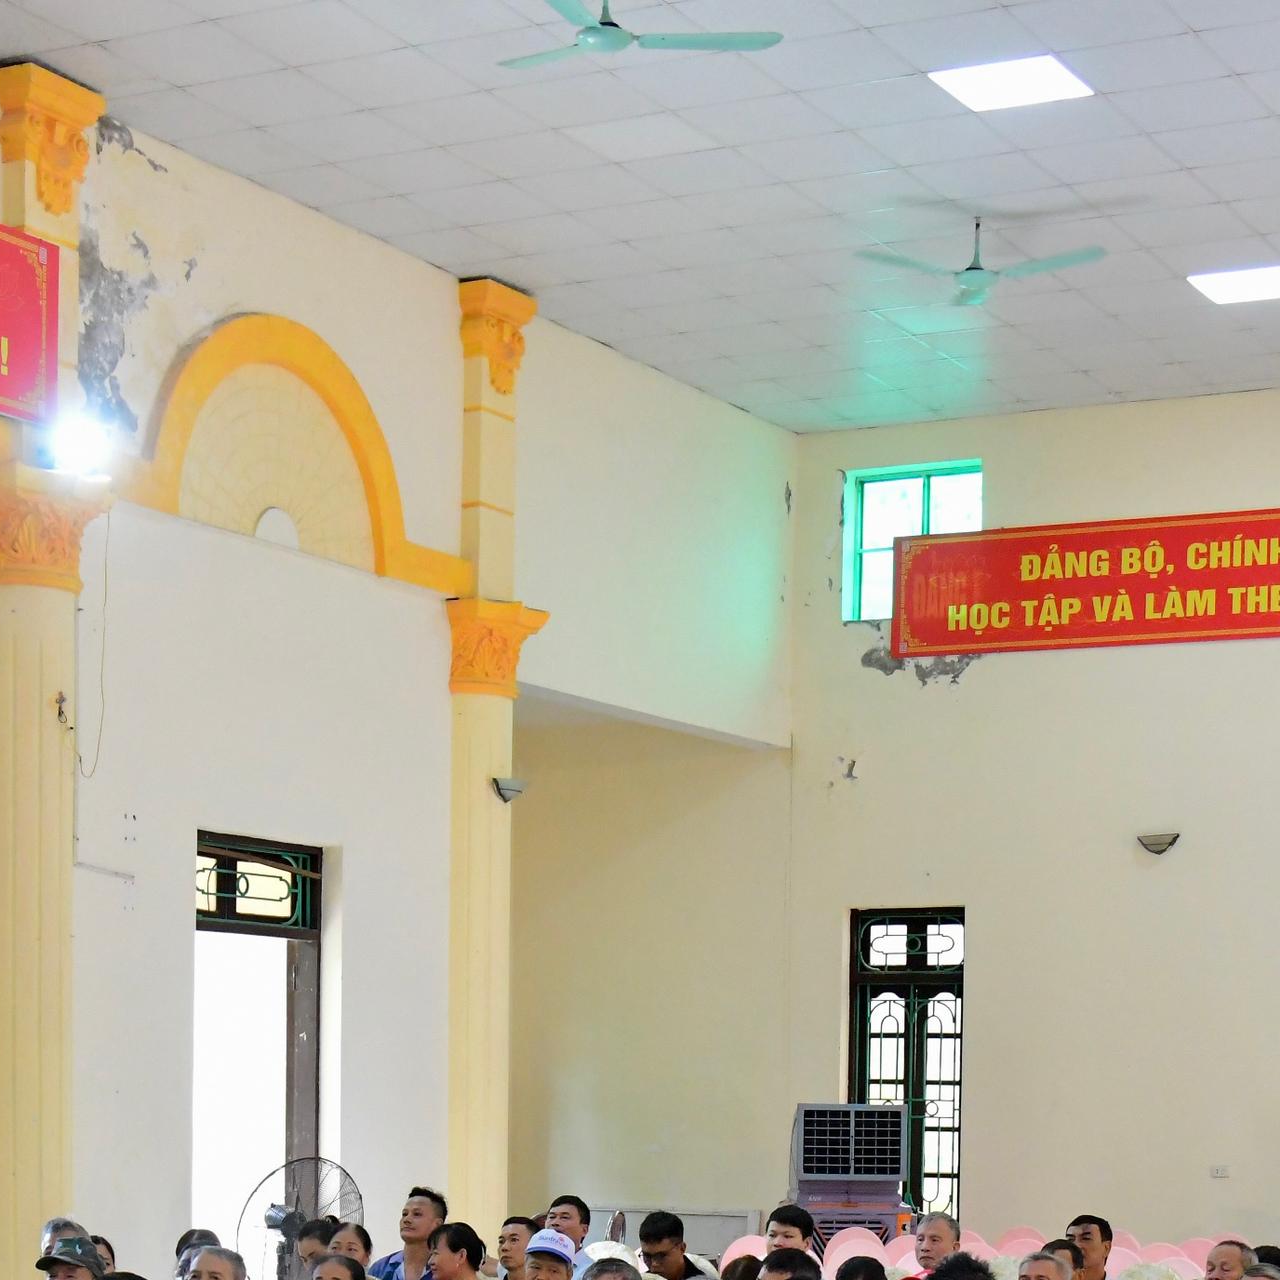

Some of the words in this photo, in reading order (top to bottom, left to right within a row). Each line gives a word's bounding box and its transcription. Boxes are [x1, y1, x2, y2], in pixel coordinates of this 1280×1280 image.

[1021, 544, 1109, 580] ĐẢNG
[1122, 541, 1174, 578] BỘ,
[948, 602, 1009, 634] HỌC
[1021, 594, 1081, 631] TẬP
[1093, 589, 1133, 622] VÀ
[1146, 583, 1216, 619] LÀM
